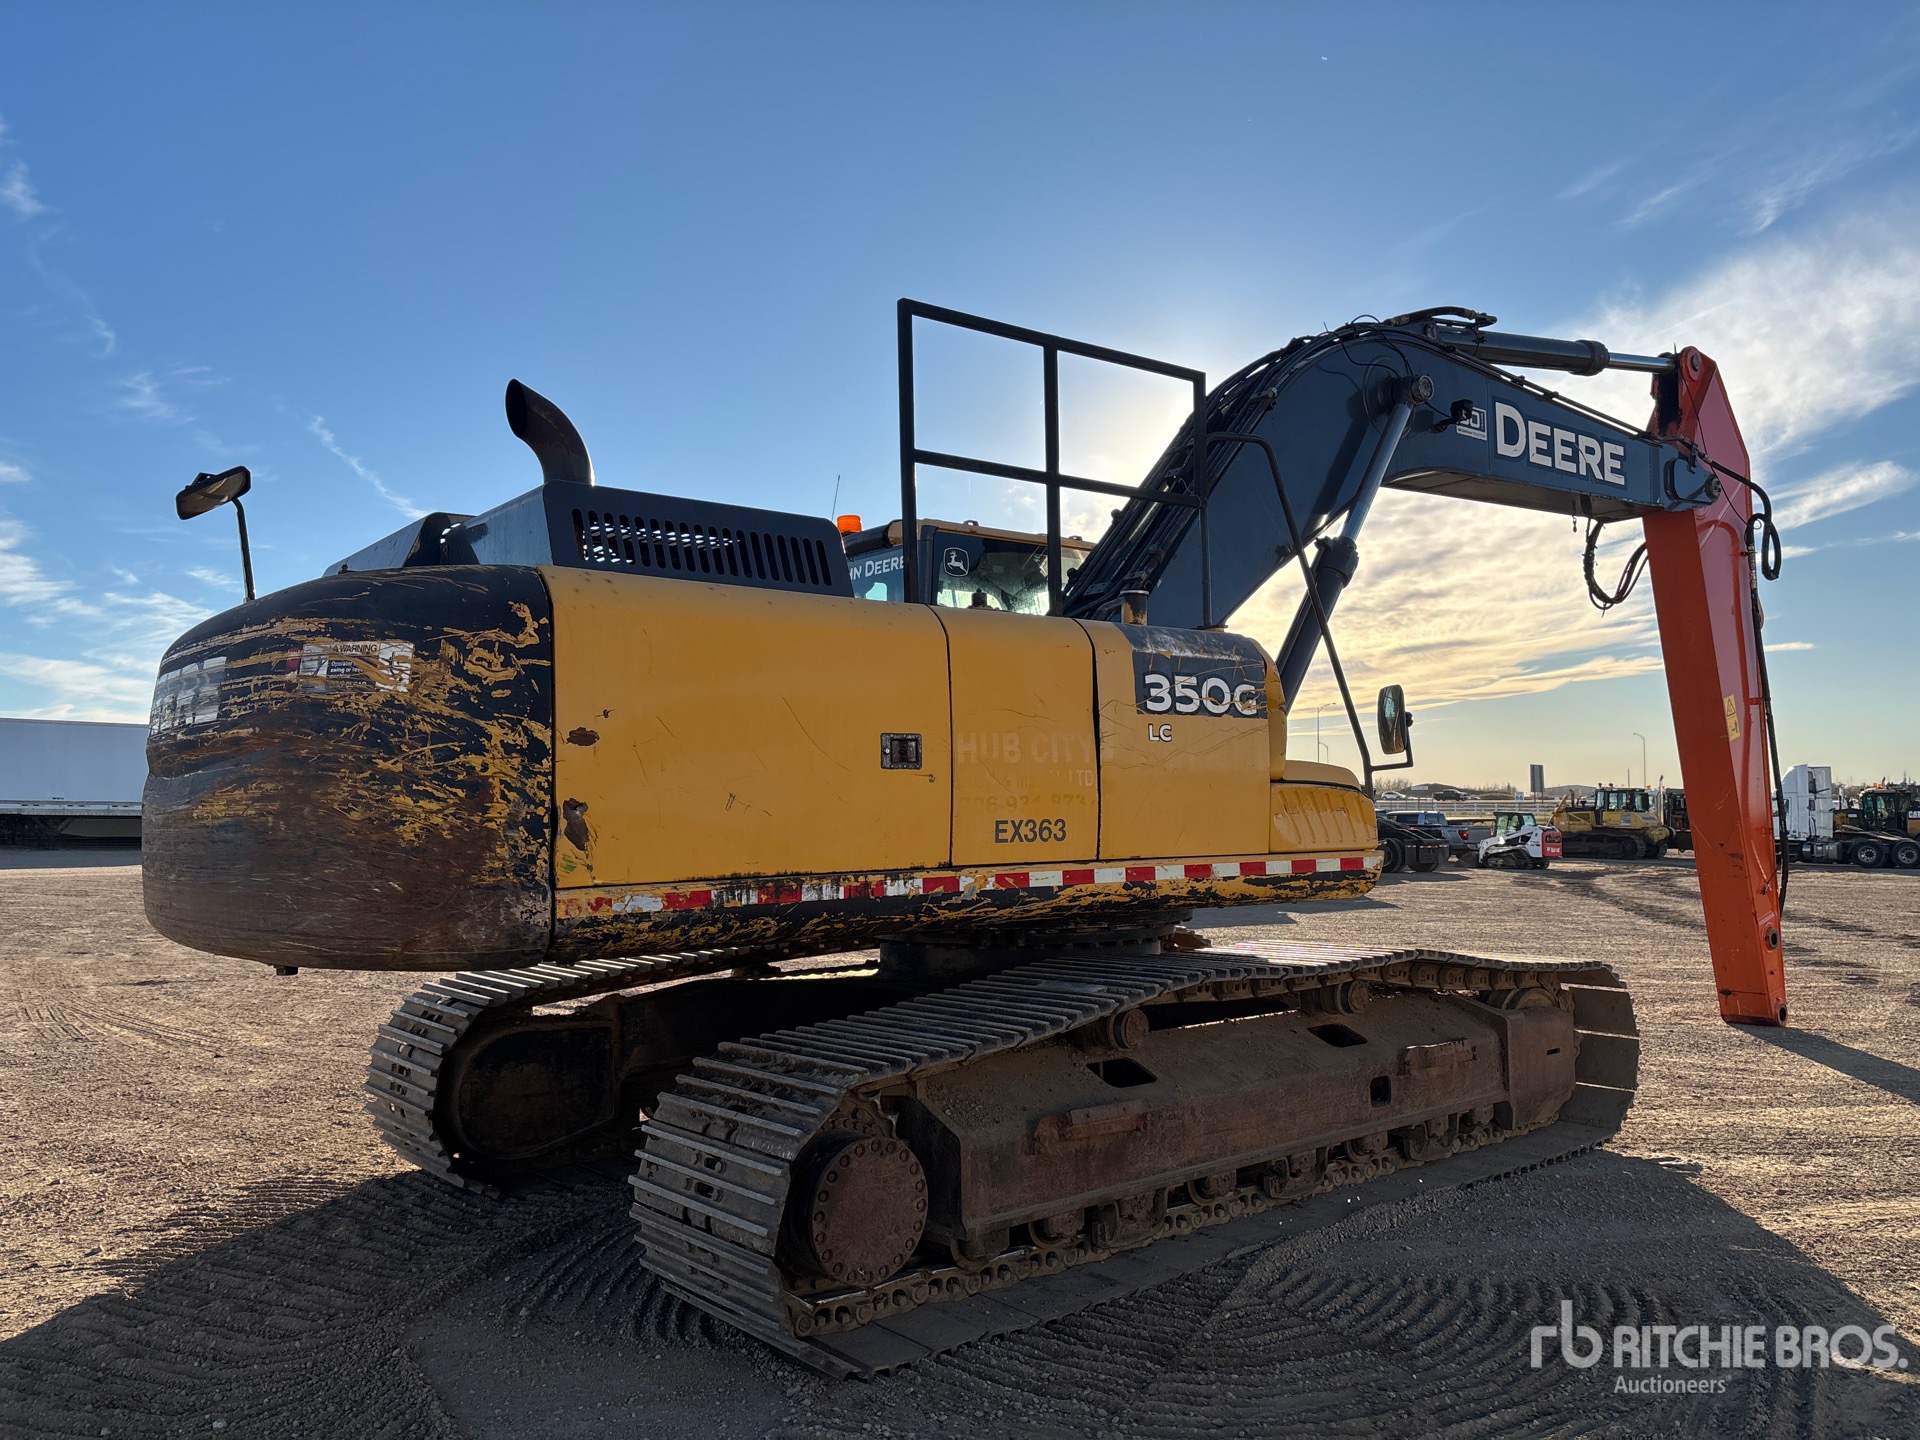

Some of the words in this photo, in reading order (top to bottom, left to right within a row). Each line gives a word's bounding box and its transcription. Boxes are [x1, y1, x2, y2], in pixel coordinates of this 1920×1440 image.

[1495, 401, 1625, 486] DEERE
[865, 555, 904, 578] DEERE
[340, 644, 378, 653] WARNING
[1144, 673, 1257, 716] 350G
[1147, 723, 1172, 742] LC
[957, 732, 1021, 764] HUB
[1030, 731, 1093, 764] CITY
[994, 818, 1067, 844] EX363
